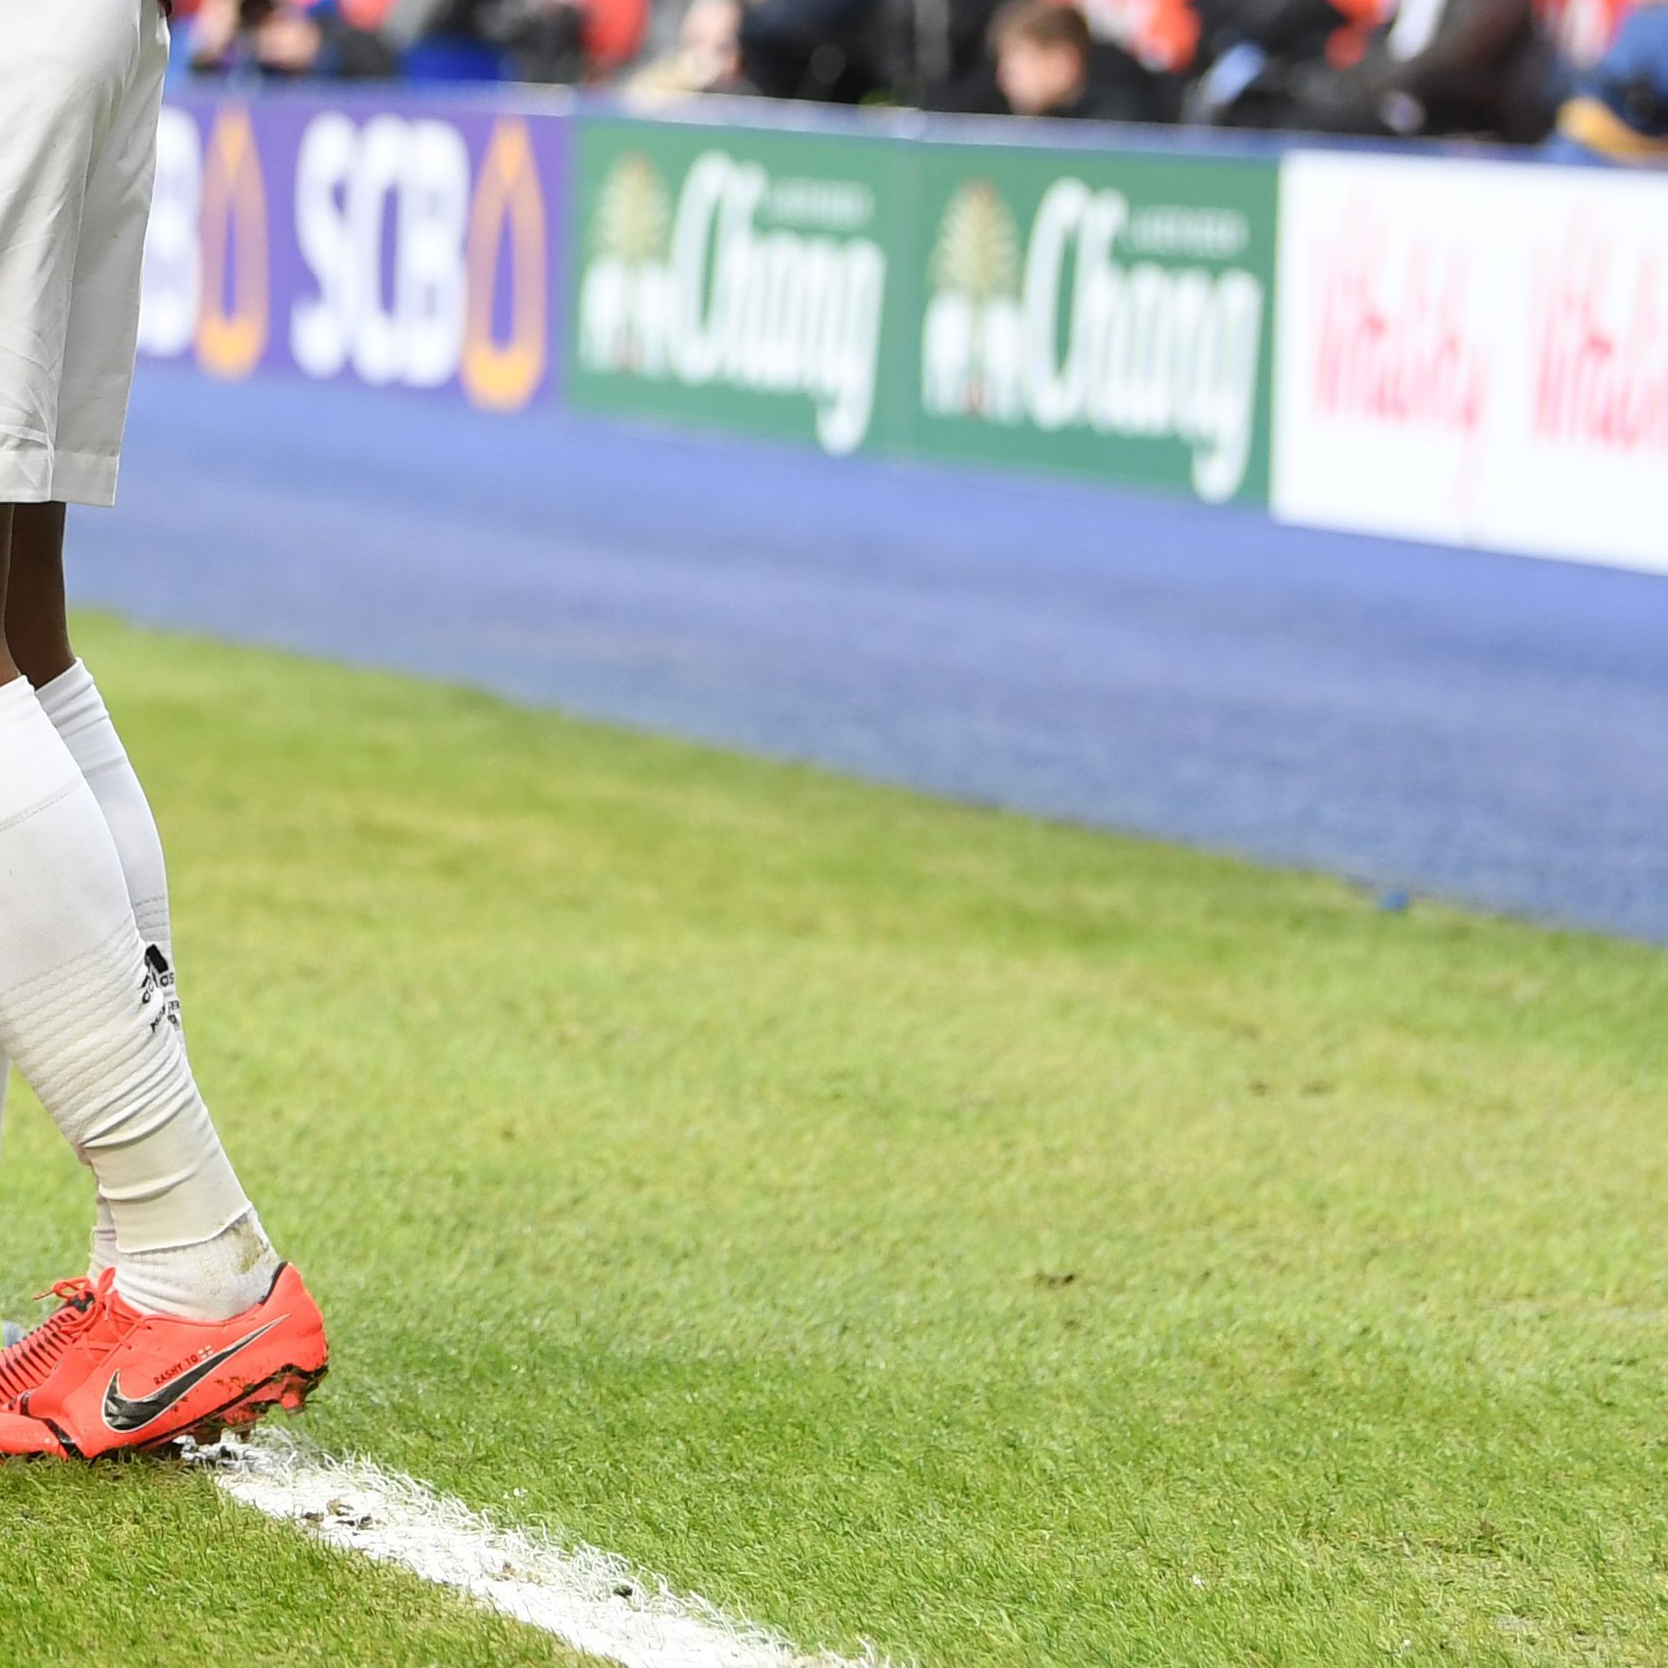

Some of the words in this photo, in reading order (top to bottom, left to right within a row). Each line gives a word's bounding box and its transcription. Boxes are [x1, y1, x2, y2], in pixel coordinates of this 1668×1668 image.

[287, 108, 470, 389] SCB
[669, 147, 889, 457] Chang
[1017, 175, 1265, 505] Chang
